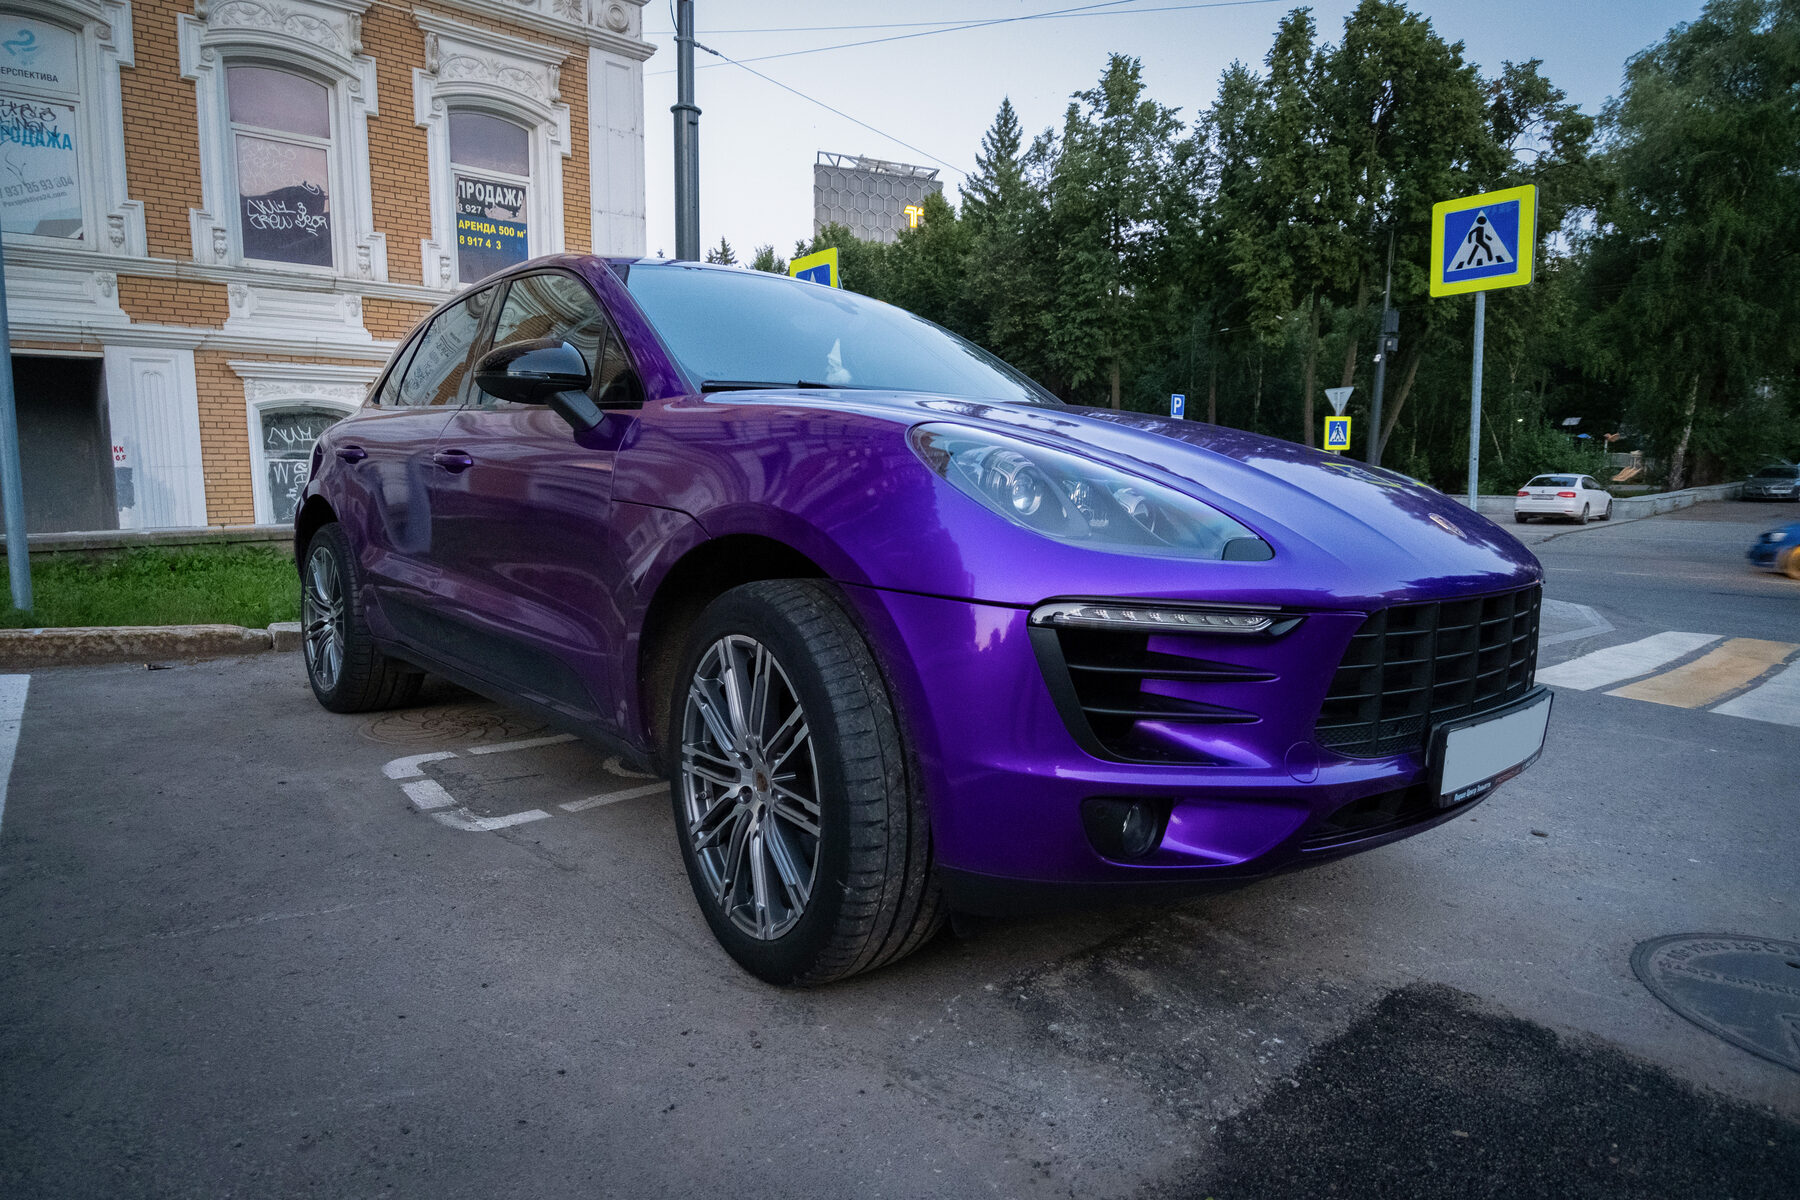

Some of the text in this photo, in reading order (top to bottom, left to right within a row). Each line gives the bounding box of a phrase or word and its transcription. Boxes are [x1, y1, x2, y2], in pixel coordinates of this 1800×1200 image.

[458, 180, 524, 207] ПРОДАЖА
[465, 204, 482, 214] 927
[458, 219, 497, 235] АРЕНДА
[498, 225, 515, 237] 500
[459, 235, 501, 250] 8 917 4 3
[1173, 397, 1182, 414] P
